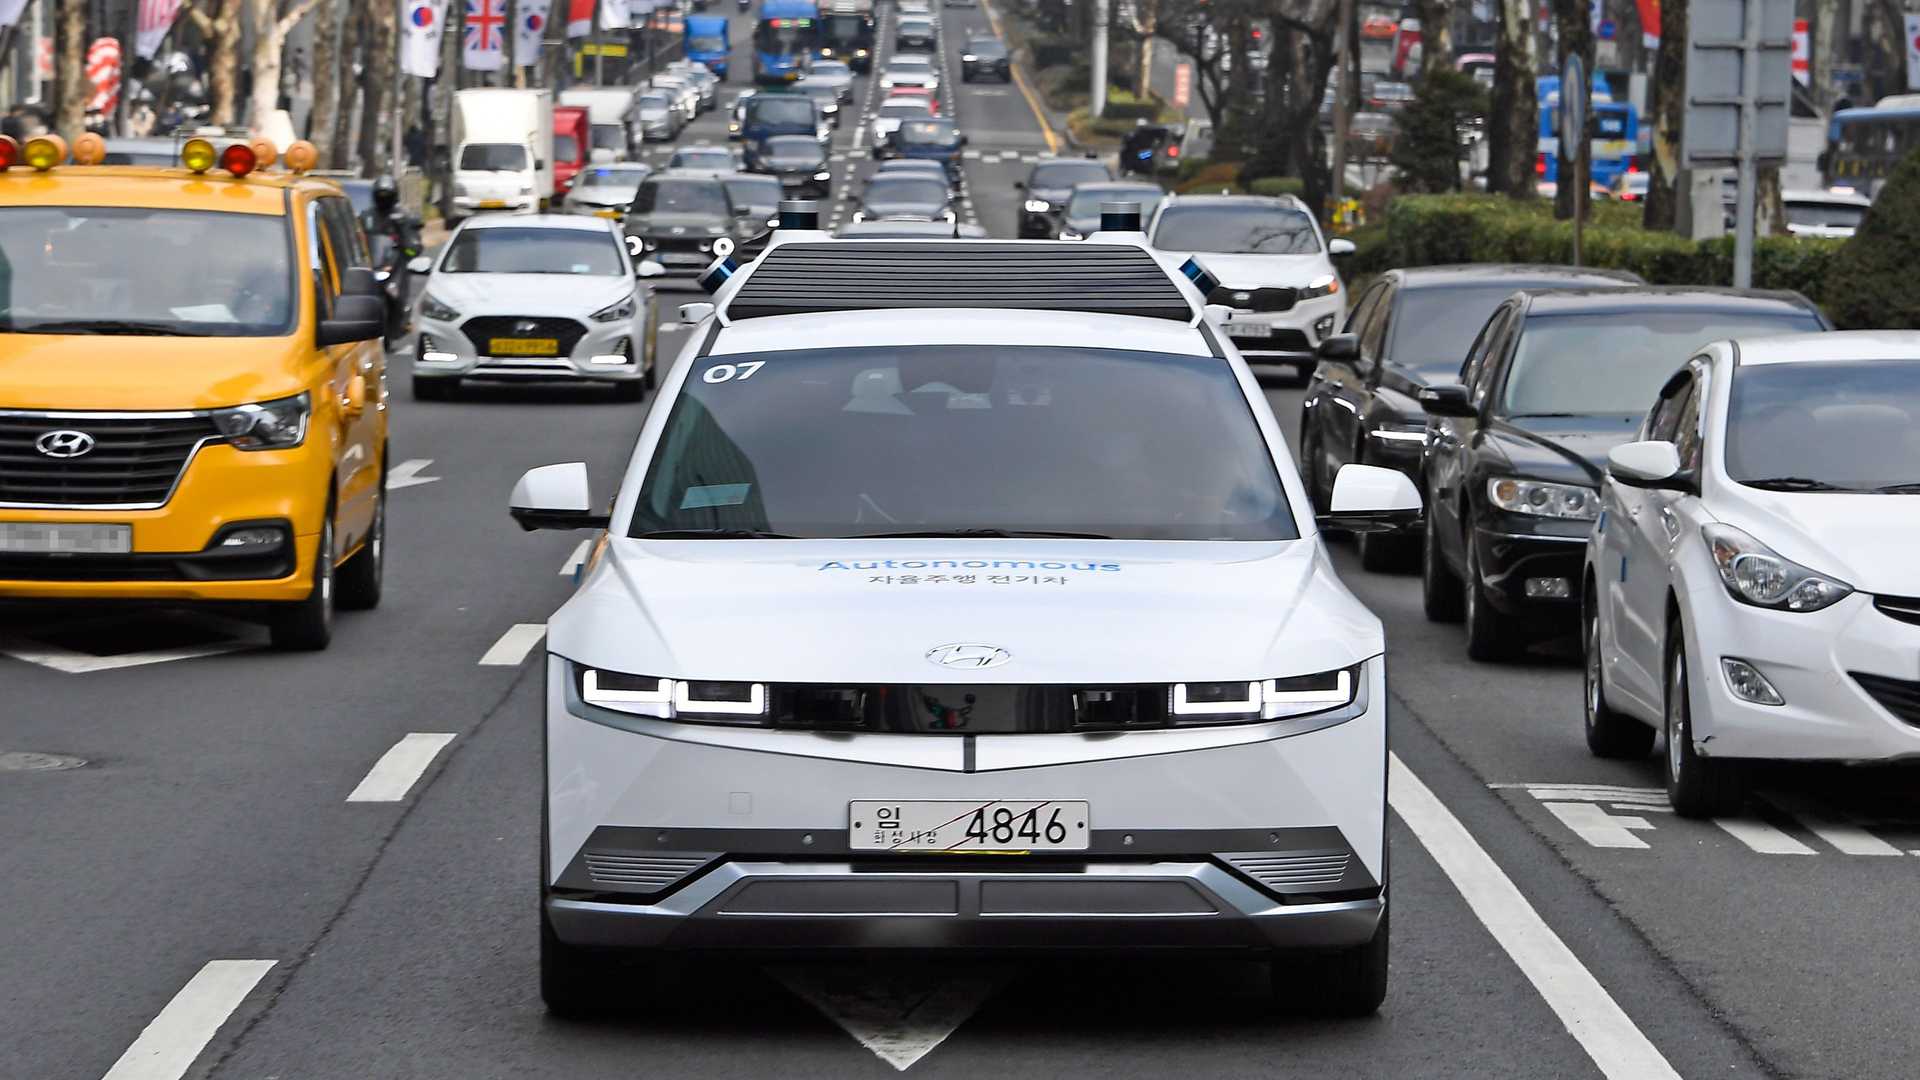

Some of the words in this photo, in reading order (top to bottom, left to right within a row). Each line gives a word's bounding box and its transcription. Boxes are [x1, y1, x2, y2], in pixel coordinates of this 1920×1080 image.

[703, 361, 767, 383] 07
[818, 560, 1121, 572] Autonomous
[868, 574, 977, 585] 자율주행
[987, 574, 1072, 585] 전기차
[877, 807, 900, 828] 임
[965, 808, 1067, 844] 4846
